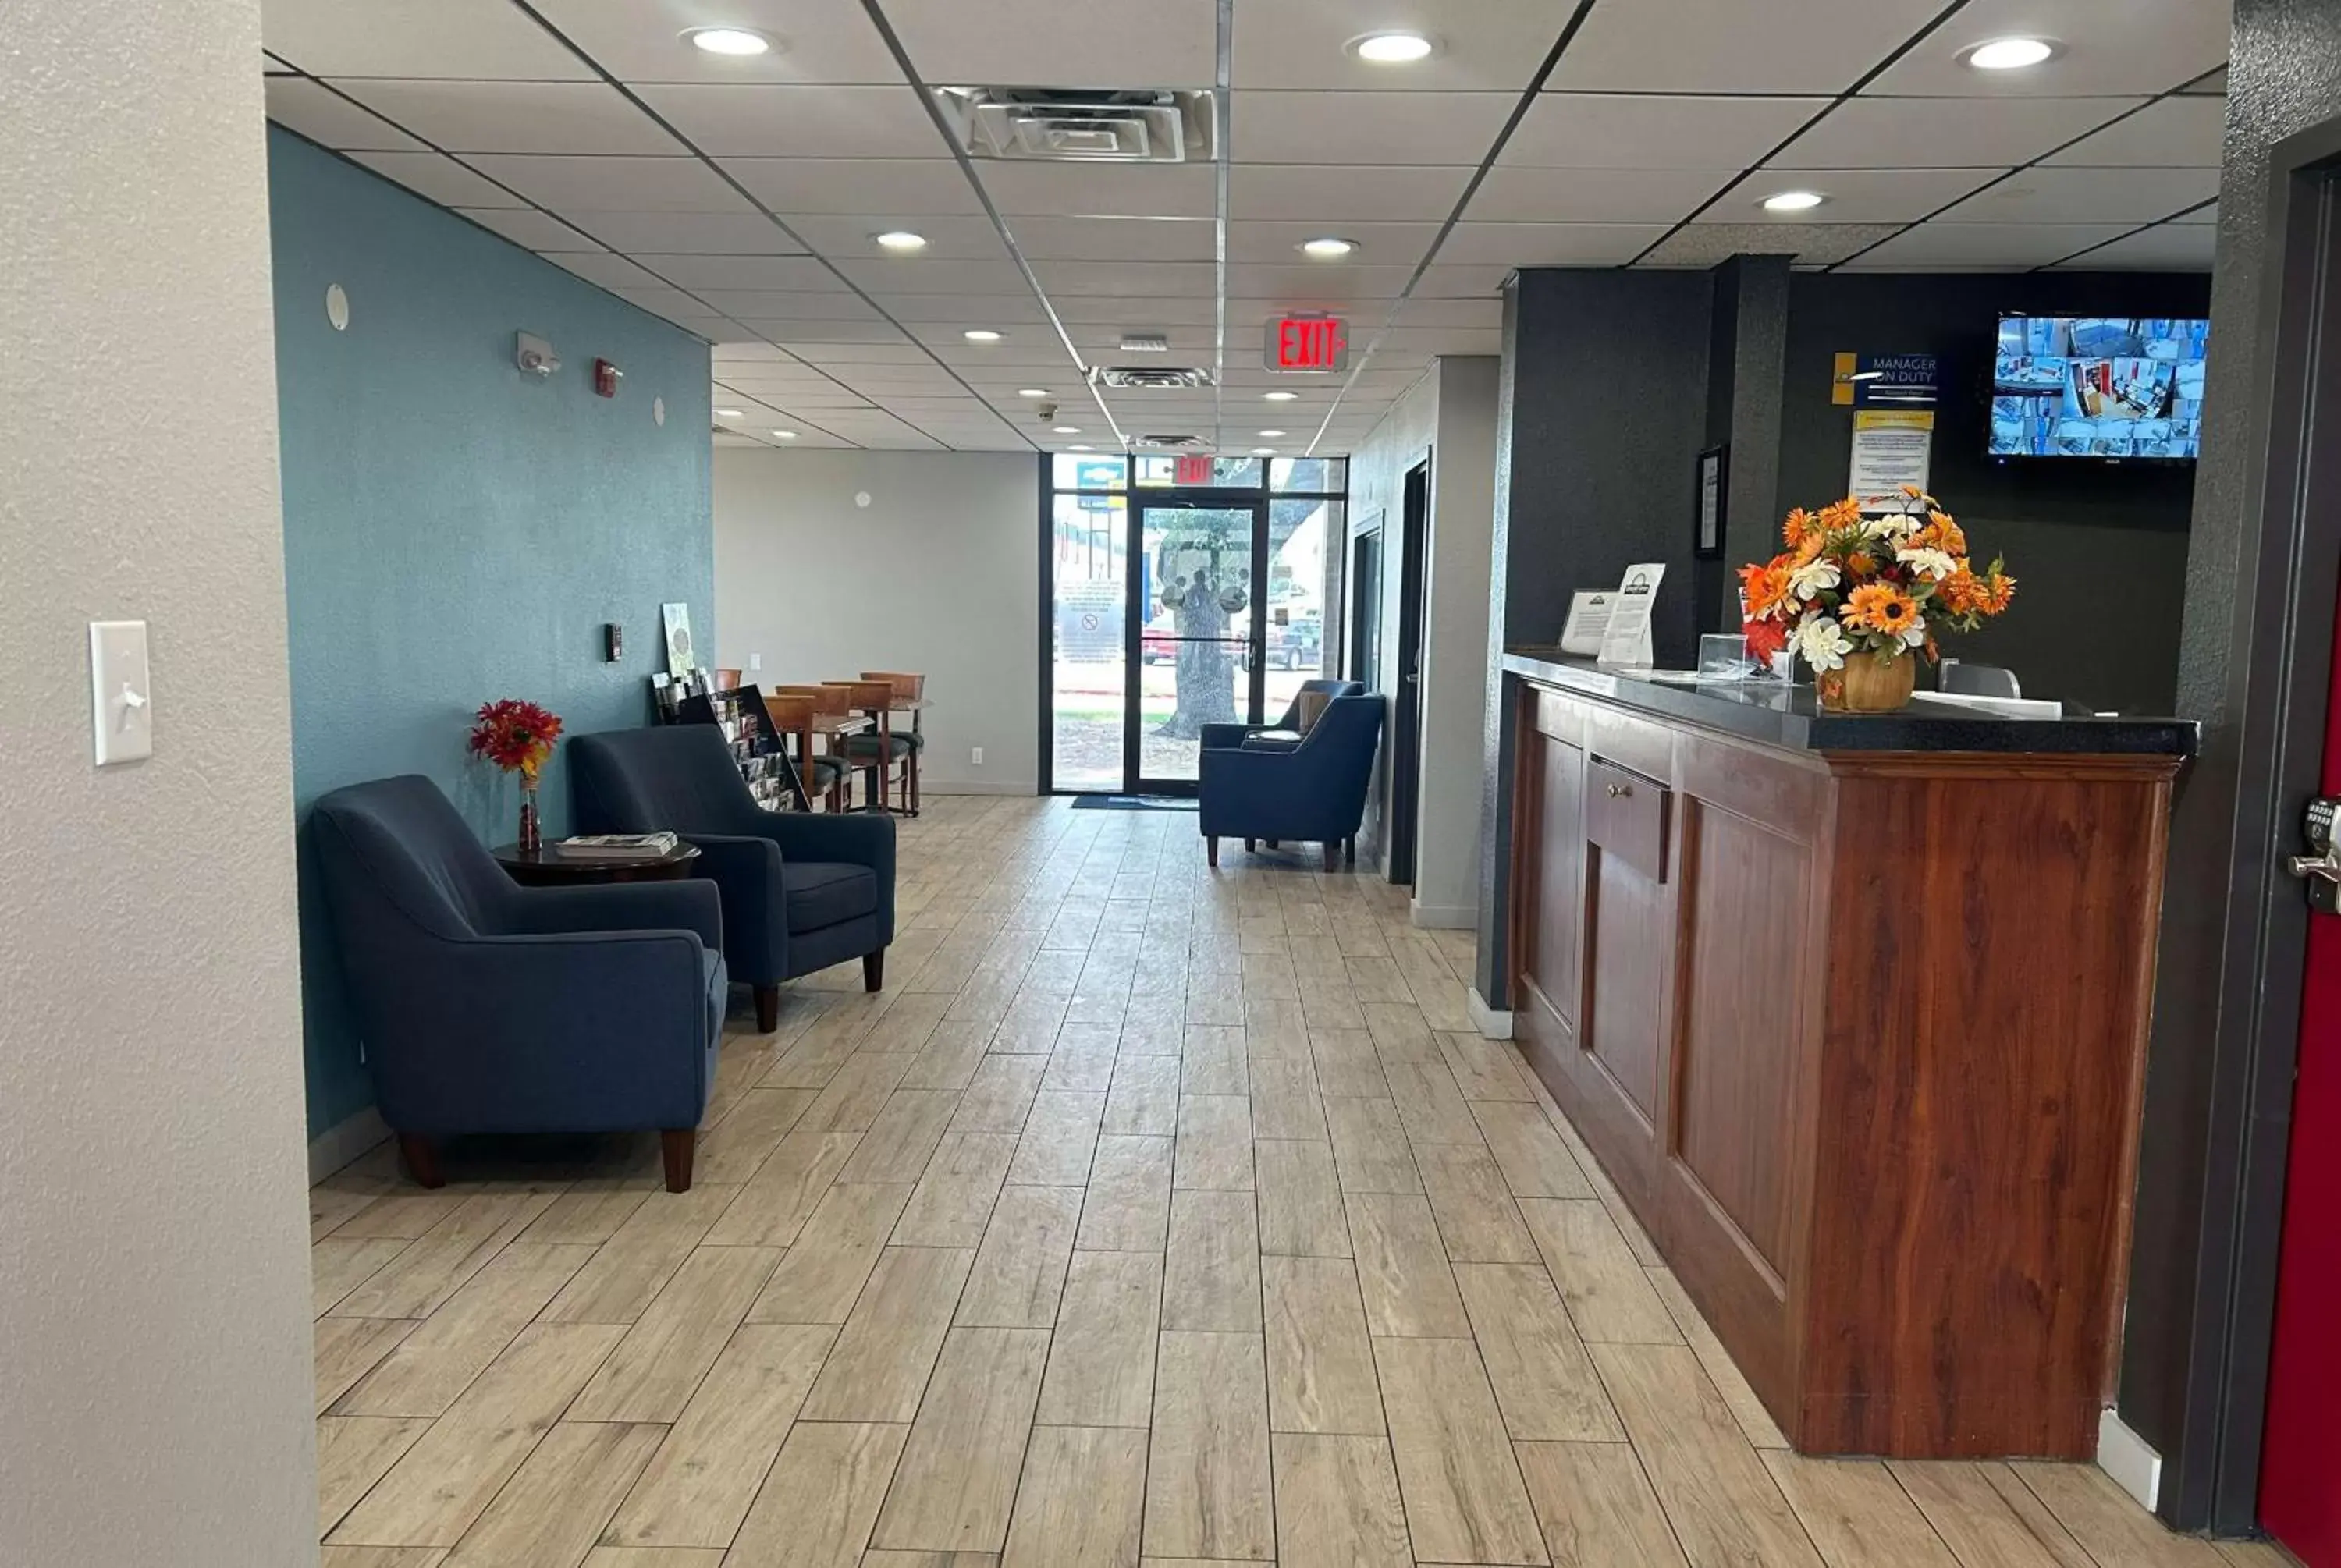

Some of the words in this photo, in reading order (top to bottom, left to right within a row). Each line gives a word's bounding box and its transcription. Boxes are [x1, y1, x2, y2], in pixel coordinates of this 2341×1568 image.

[1278, 319, 1337, 367] EXIT
[1873, 357, 1936, 370] MANAGER
[1875, 371, 1895, 382] ON
[1898, 371, 1933, 383] DUTY
[1178, 457, 1210, 484] EXIT
